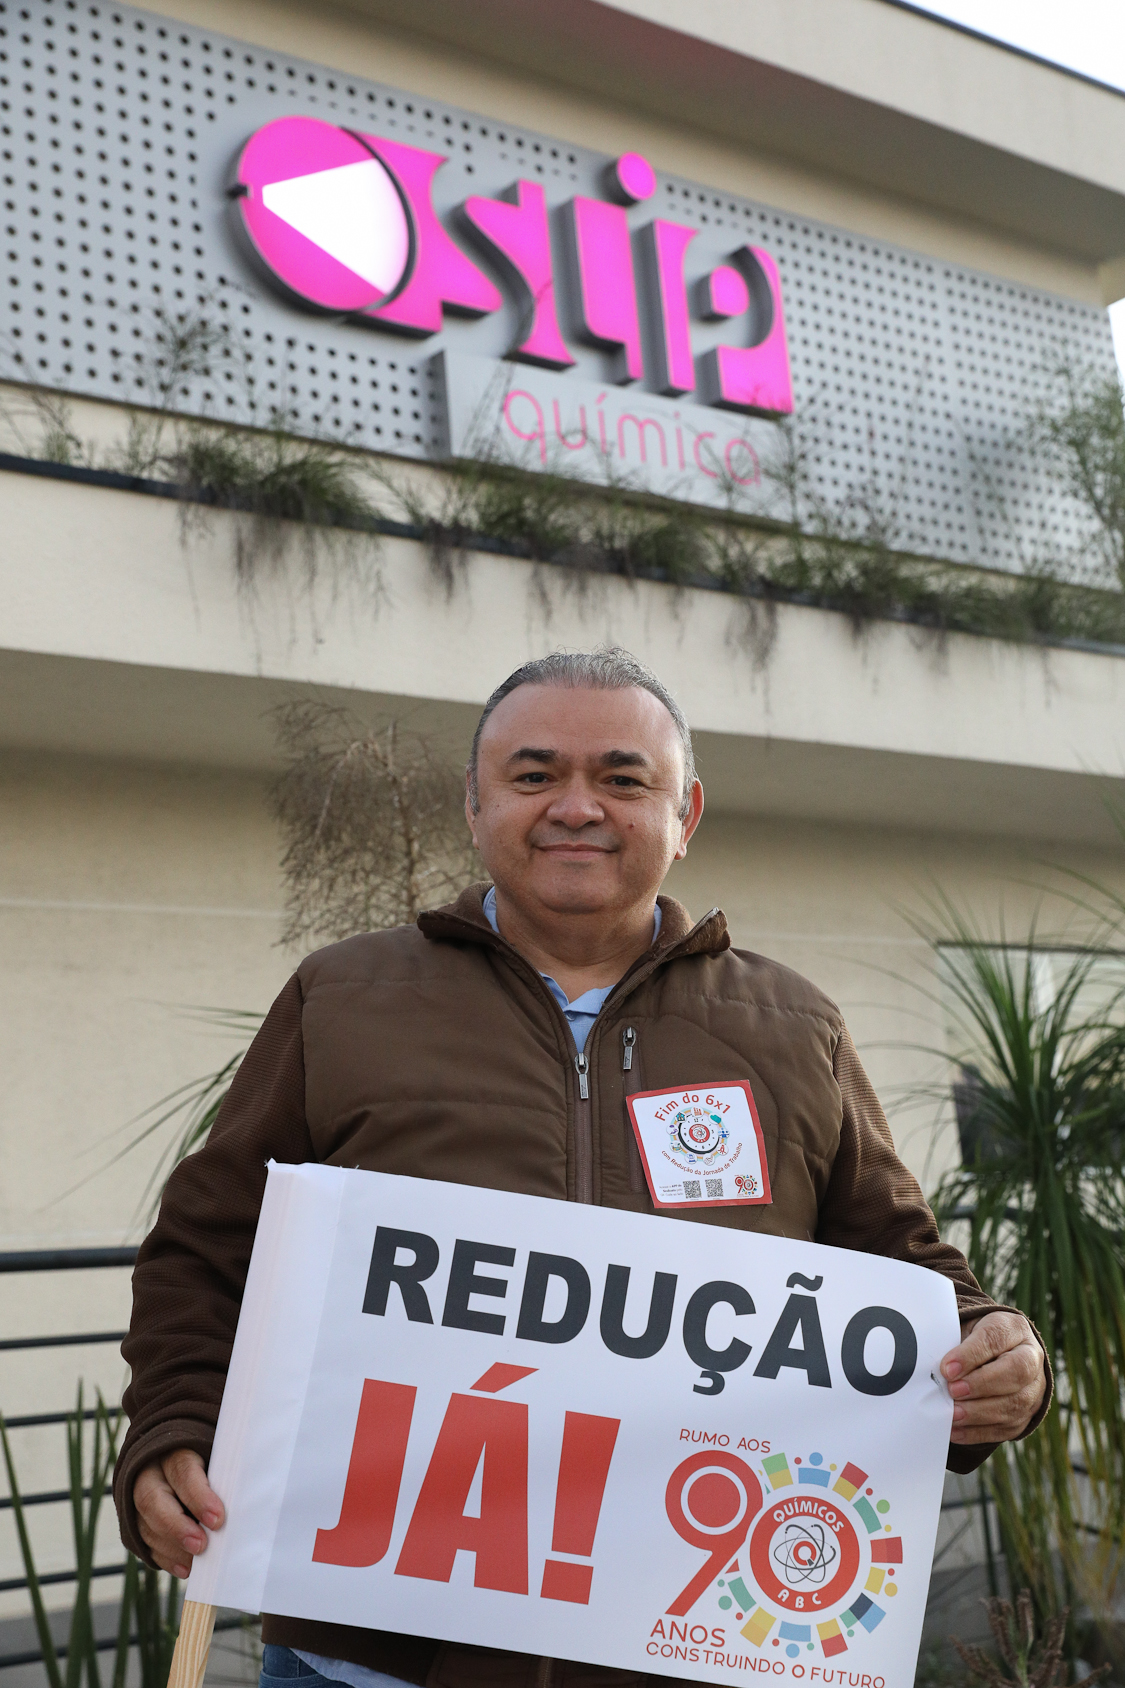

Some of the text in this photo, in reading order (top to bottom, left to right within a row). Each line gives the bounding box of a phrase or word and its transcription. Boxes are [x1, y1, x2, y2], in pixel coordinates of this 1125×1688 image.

[654, 1092, 731, 1121] Fim do 6x1
[661, 1150, 671, 1161] com
[670, 1158, 694, 1174] Redução
[702, 1166, 724, 1176] Jornada
[723, 1162, 731, 1170] de
[728, 1142, 743, 1164] Trabalho
[362, 1225, 918, 1397] REDUÇÃO
[679, 1428, 771, 1454] RUMO AOS
[311, 1361, 621, 1605] JÁ!
[773, 1497, 844, 1533] QUÍMICOS
[650, 1618, 726, 1648] ANOS
[646, 1641, 886, 1688] CONSTRUINDO O FUTURO
